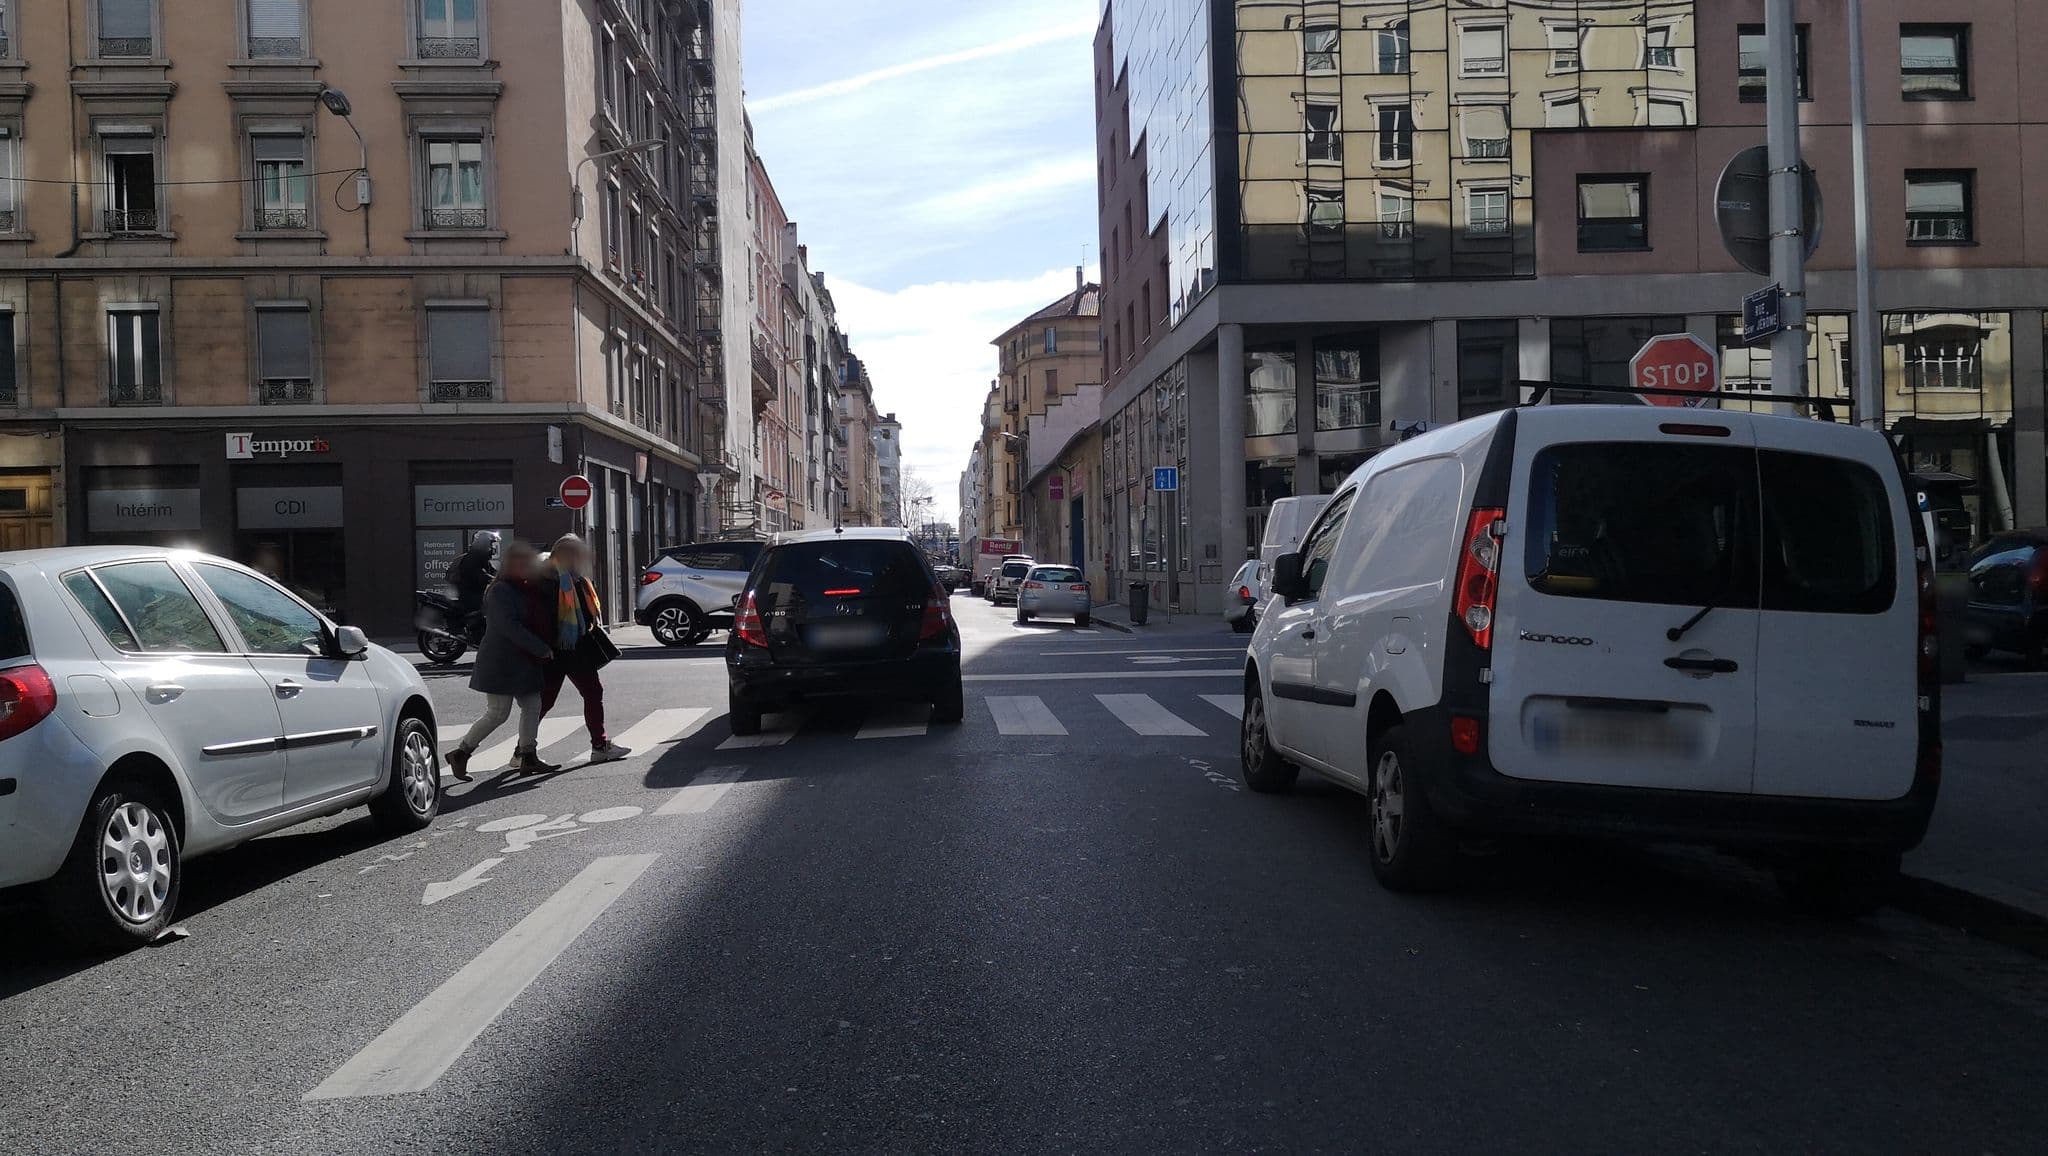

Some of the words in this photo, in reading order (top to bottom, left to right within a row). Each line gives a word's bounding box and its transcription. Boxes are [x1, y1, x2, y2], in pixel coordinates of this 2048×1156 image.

[1754, 303, 1766, 317] RUE
[1642, 362, 1709, 388] STOP
[231, 434, 330, 458] Temporis
[116, 503, 173, 518] Intérim
[274, 500, 307, 515] CDI
[423, 498, 505, 512] Formation
